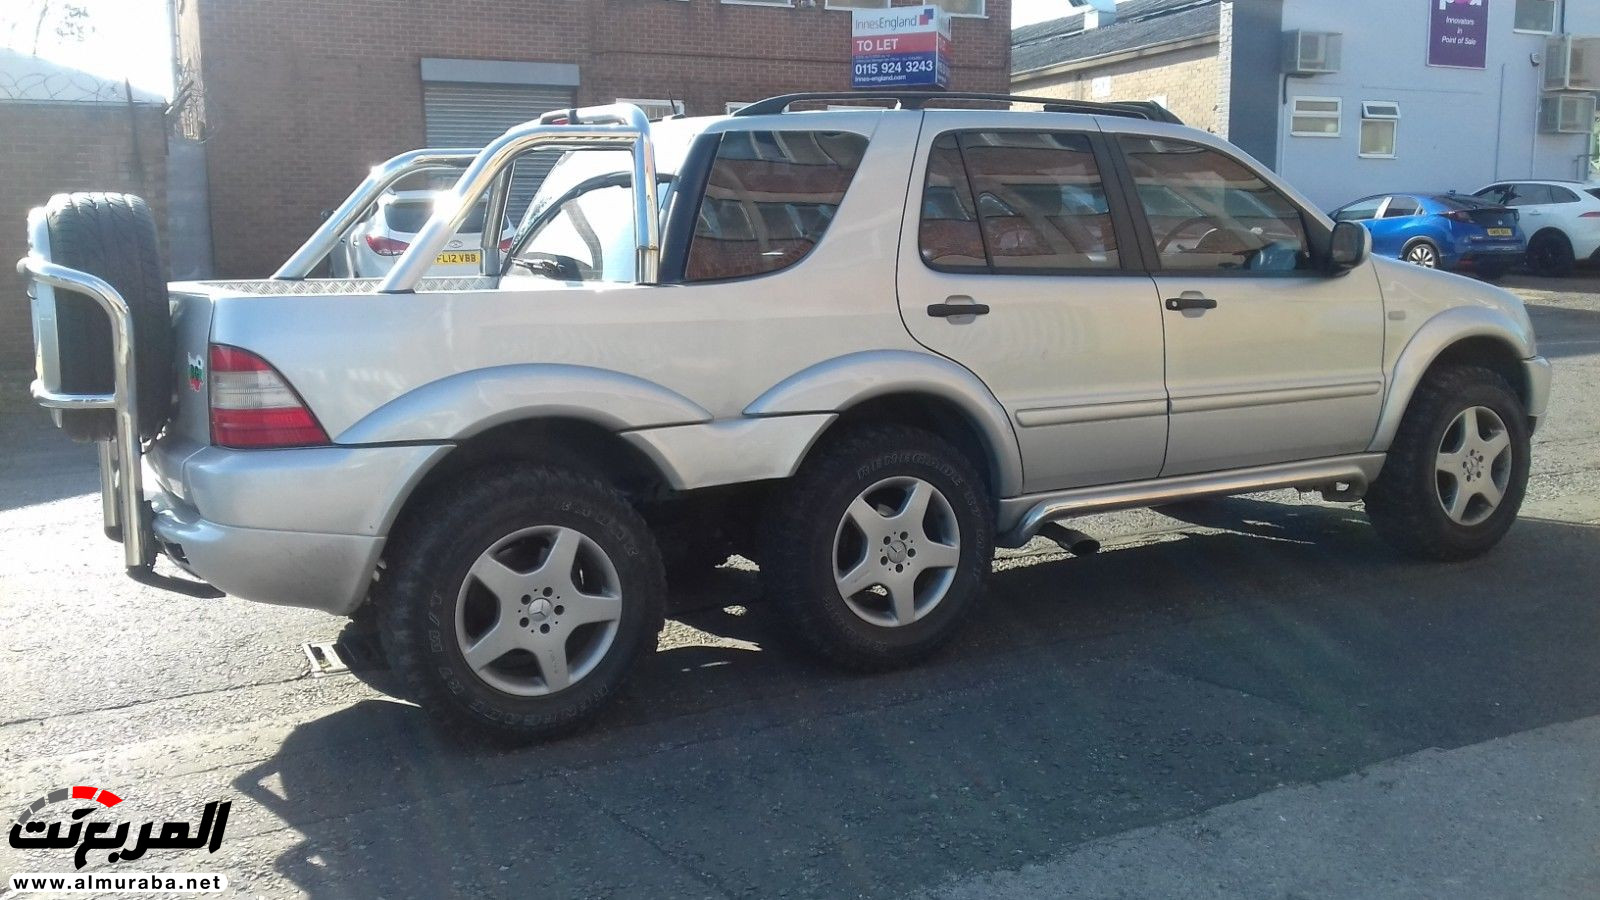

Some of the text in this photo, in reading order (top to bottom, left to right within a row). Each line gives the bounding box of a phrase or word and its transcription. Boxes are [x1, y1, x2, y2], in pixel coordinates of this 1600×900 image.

[855, 15, 917, 31] InnesEngland
[856, 38, 898, 52] TO LET
[1441, 35, 1457, 44] Point
[1464, 37, 1477, 46] Sale
[855, 60, 933, 75] 0115 924 3243
[436, 254, 477, 263] FL12 VBB
